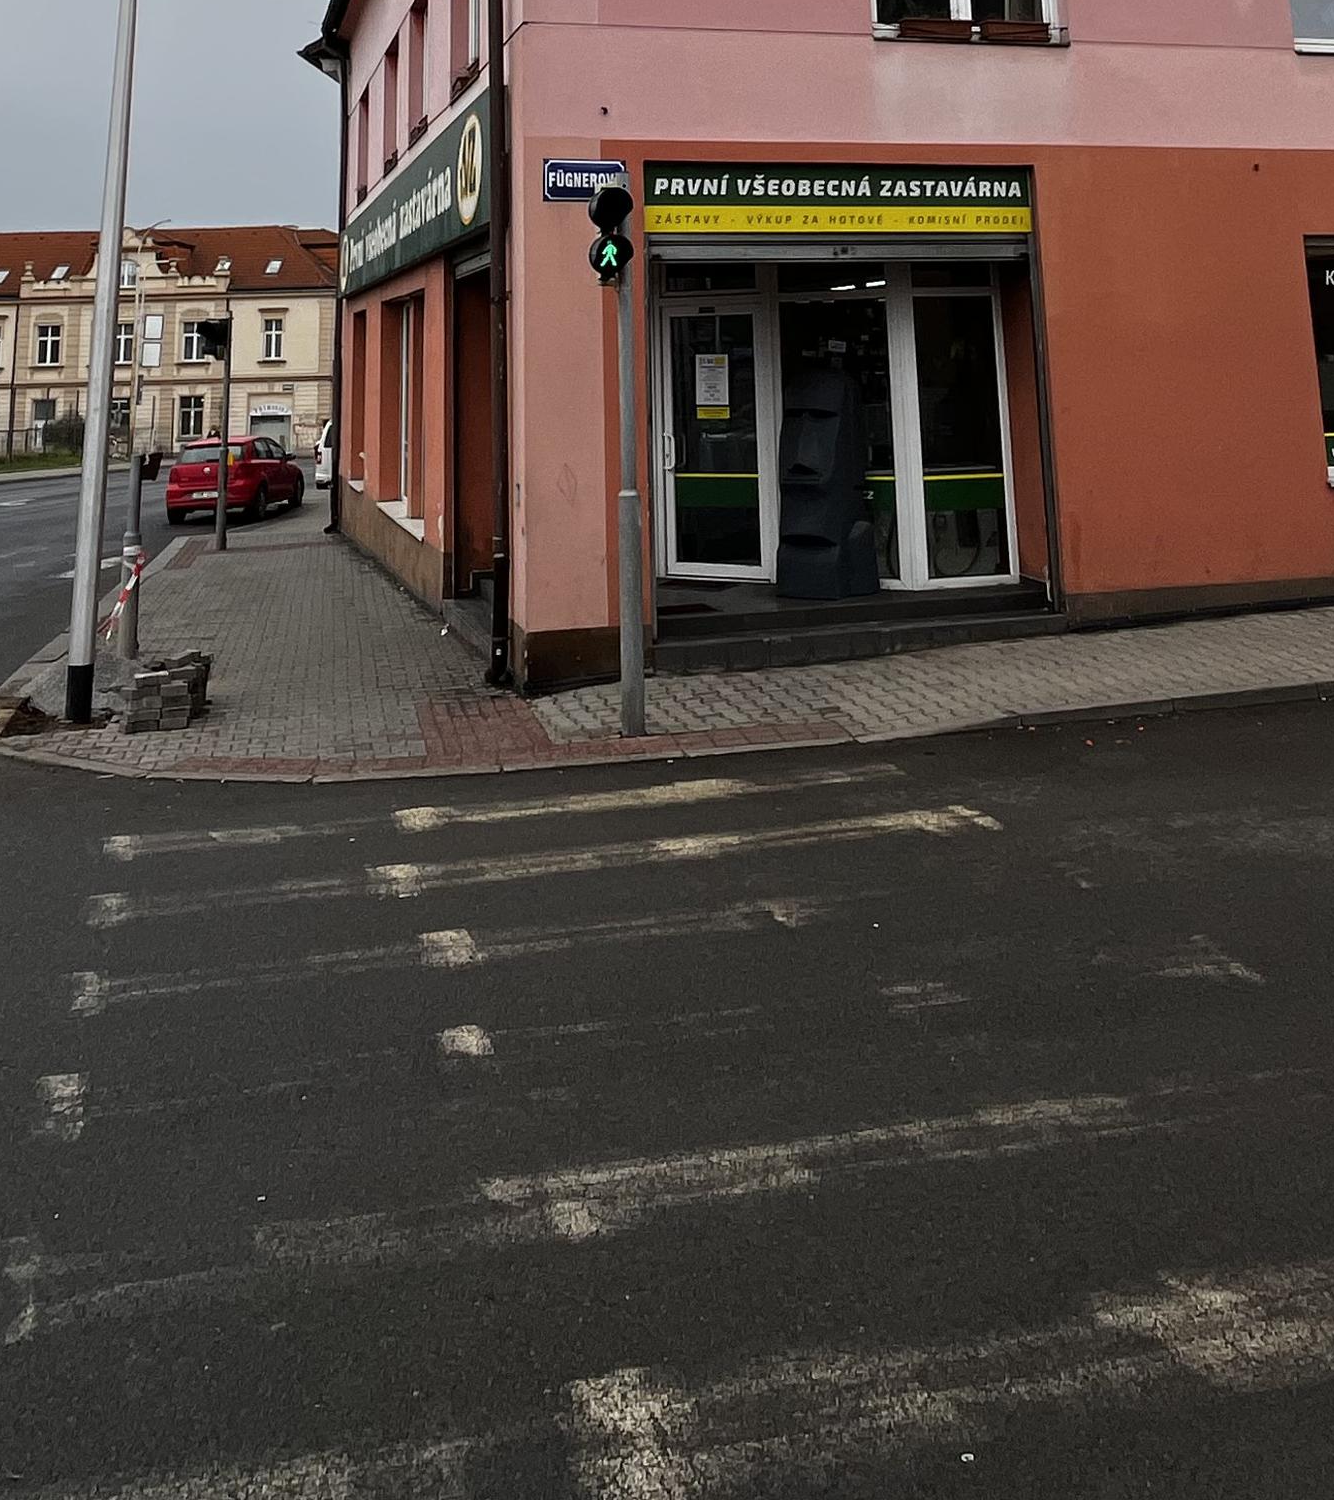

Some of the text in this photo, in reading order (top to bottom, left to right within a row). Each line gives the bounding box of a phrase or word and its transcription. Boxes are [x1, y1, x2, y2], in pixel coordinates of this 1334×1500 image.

[654, 173, 1022, 198] PRVNÍ VŠEOBECNÁ ZASTAVÁRNA
[655, 211, 720, 225] ZÁSTAVY
[747, 211, 792, 225] VÝKUP
[802, 215, 819, 225] ZA
[829, 213, 883, 225] HOTOVÉ
[908, 213, 966, 225] KOMISNÍ
